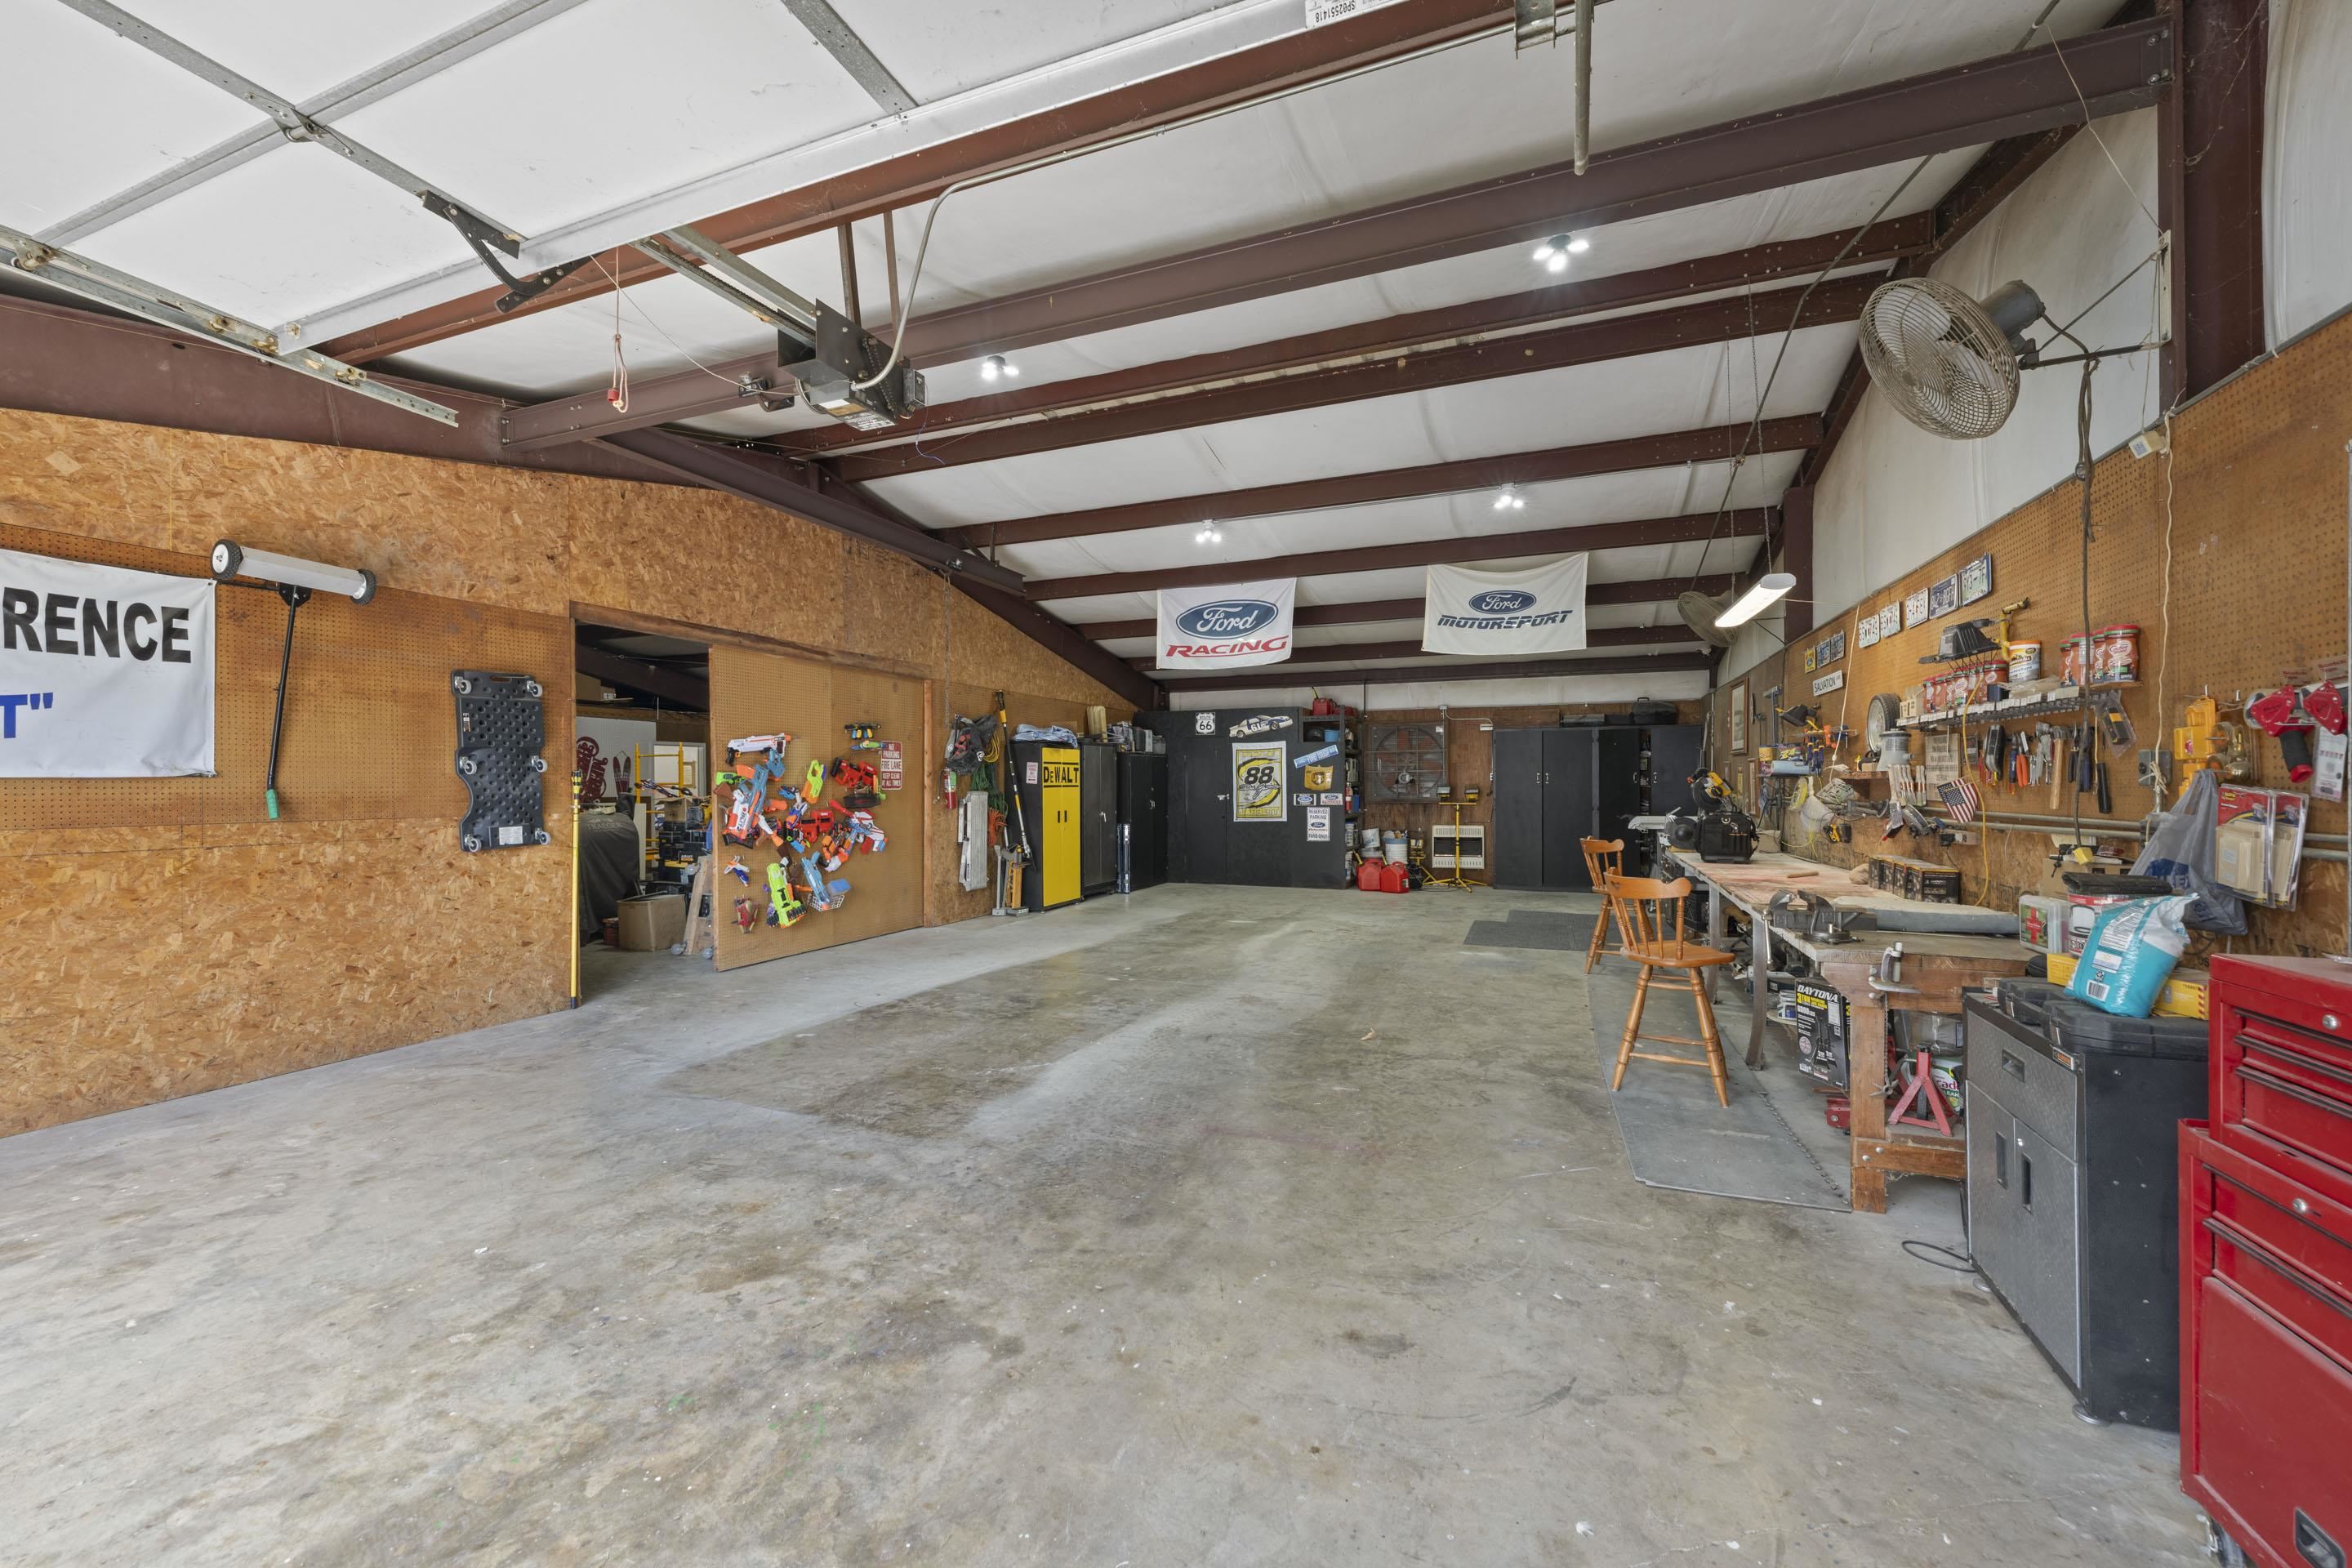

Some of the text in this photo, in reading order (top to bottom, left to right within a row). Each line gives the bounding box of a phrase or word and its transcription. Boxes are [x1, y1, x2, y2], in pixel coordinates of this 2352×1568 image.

[1481, 594, 1523, 610] Ford
[2, 586, 192, 664] RENCE
[1196, 606, 1259, 632] Ford
[1437, 610, 1573, 630] MOTORSPORT
[1166, 635, 1289, 658] RACING
[1814, 676, 1836, 693] SALVATION
[1200, 720, 1212, 731] 66
[882, 760, 902, 770] FIRE LANE
[1244, 766, 1275, 784] 88
[1797, 984, 1838, 1003] DAYTONA
